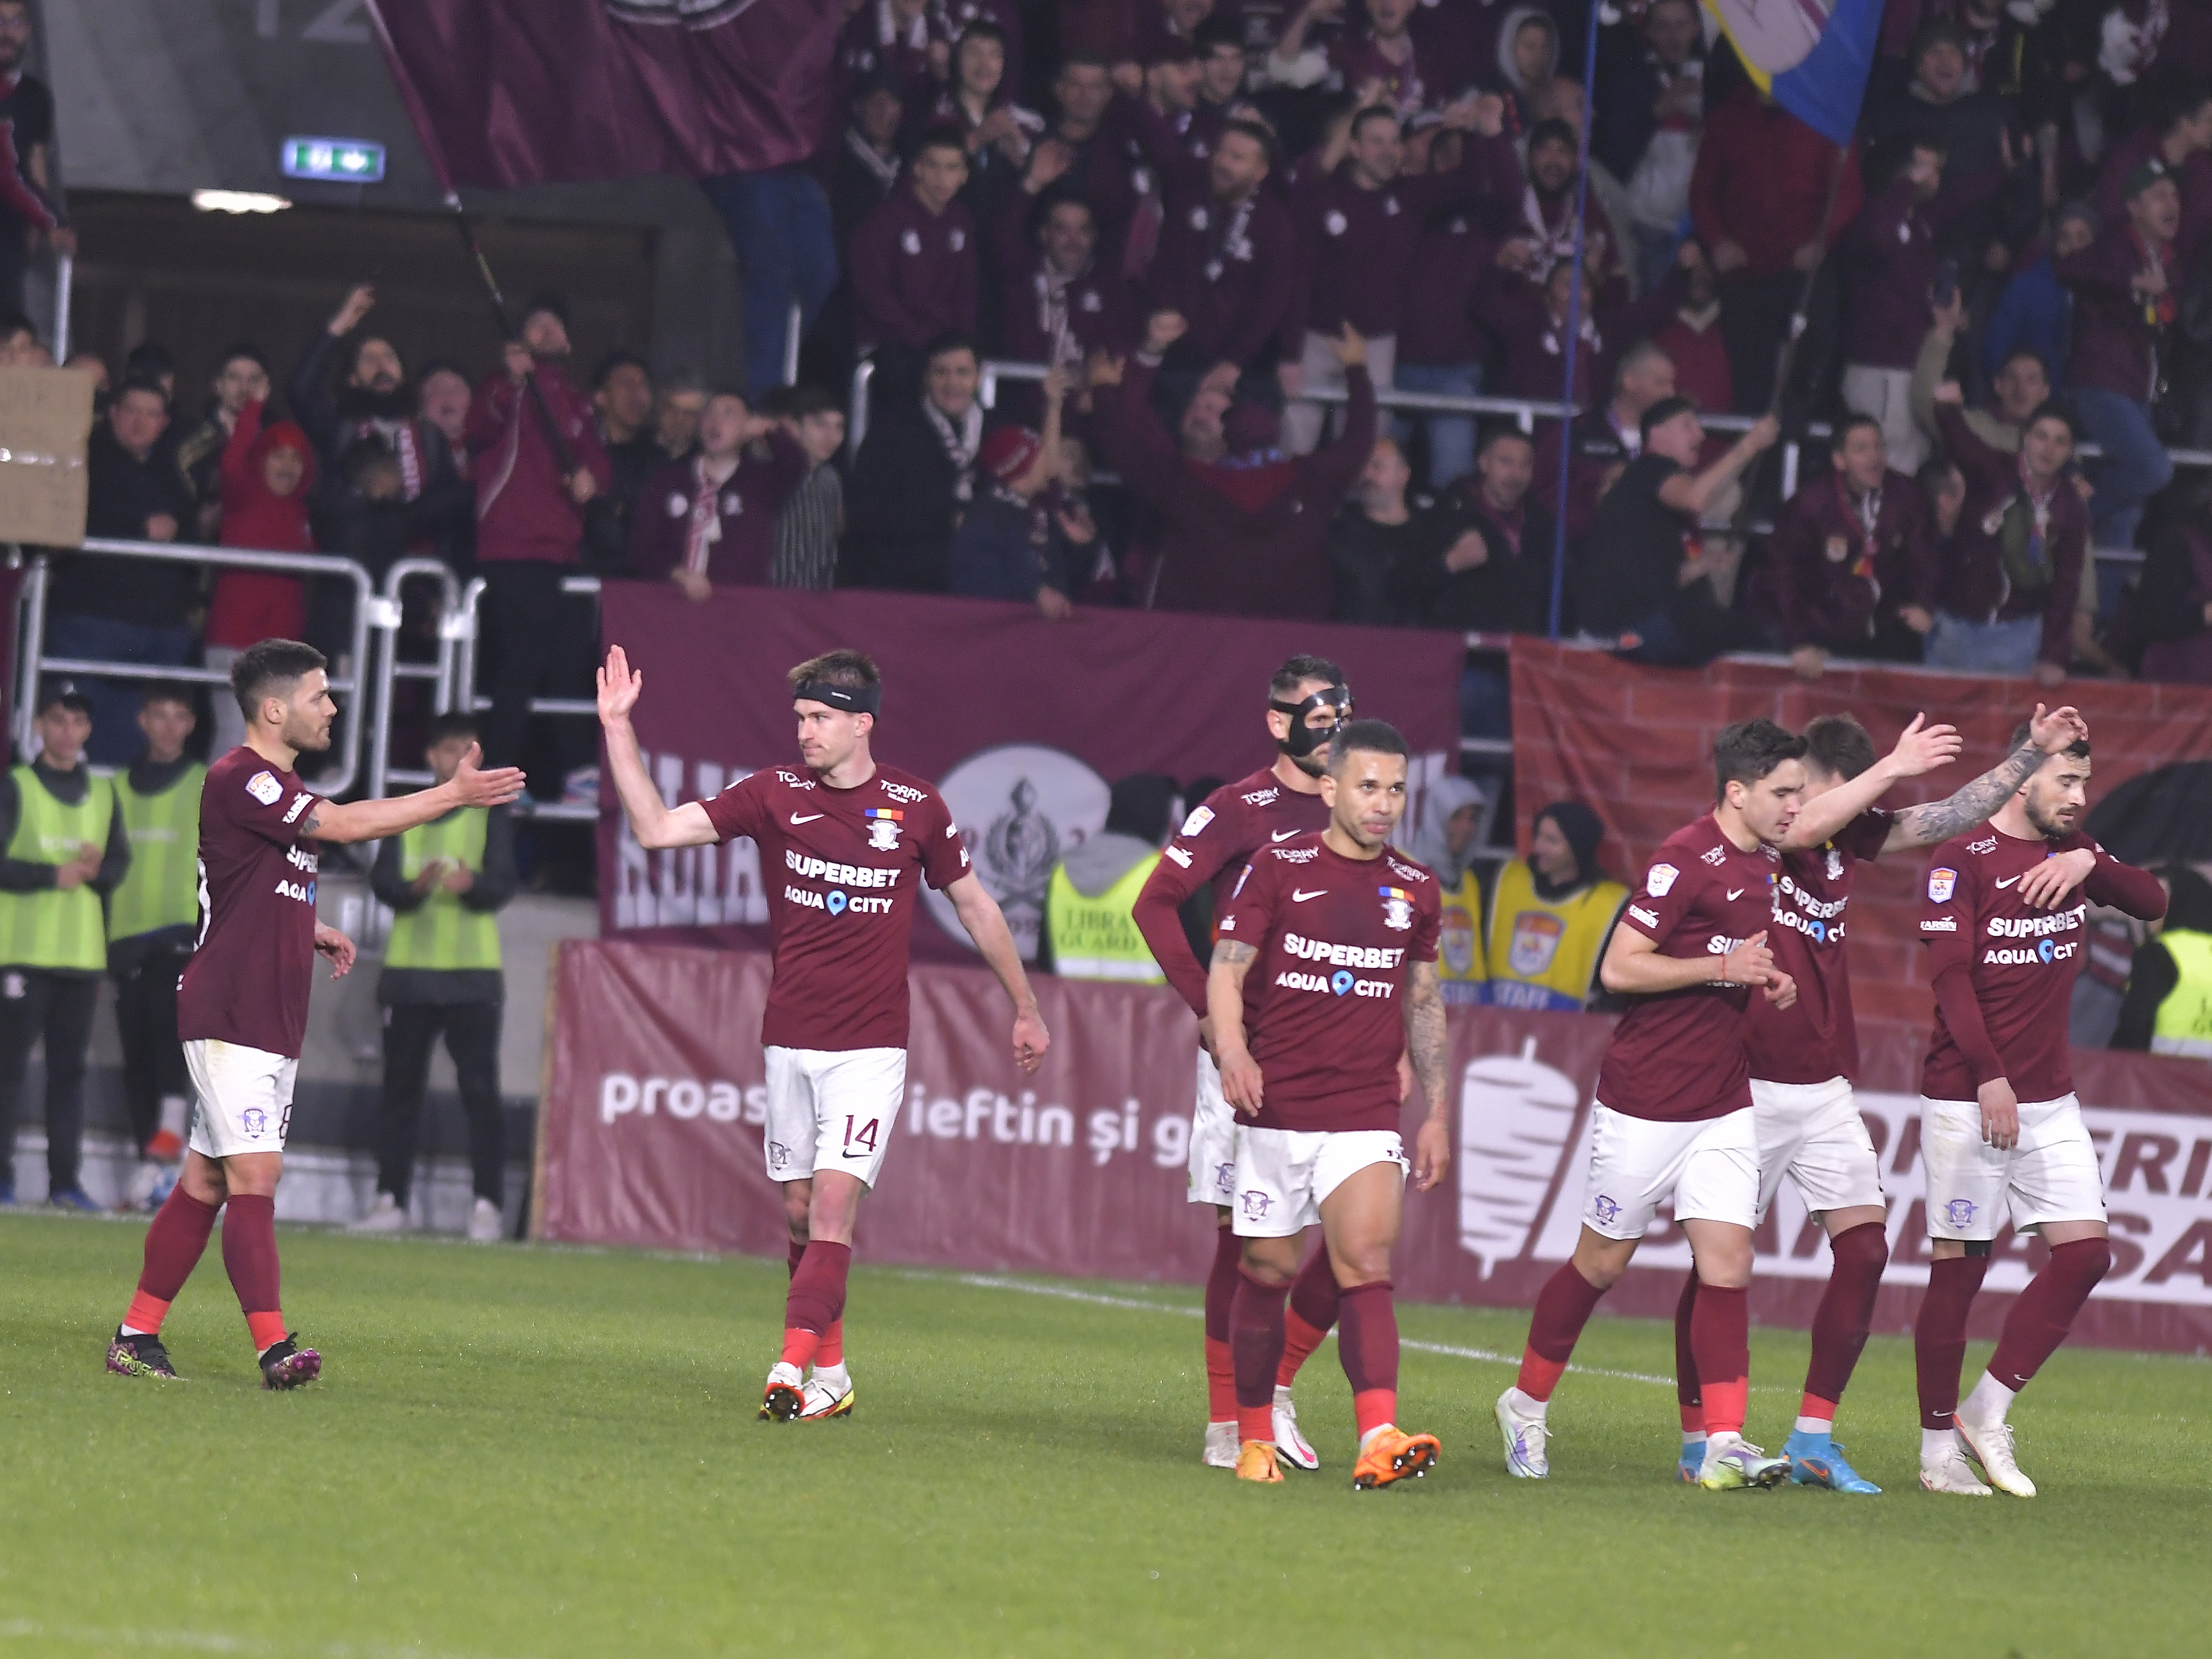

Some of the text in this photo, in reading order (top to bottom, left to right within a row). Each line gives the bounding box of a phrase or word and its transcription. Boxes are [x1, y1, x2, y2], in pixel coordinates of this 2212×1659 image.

[880, 779, 928, 803] TORRY
[785, 848, 901, 888] SUPERBET
[1271, 845, 1319, 860] TORRY
[785, 885, 893, 914] AQUA CITY
[1987, 903, 2087, 938] SUPERBET
[1283, 932, 1405, 968] SUPERBET
[1983, 949, 2039, 965] AQUA
[1275, 970, 1394, 999] AQUA CITY
[602, 1072, 767, 1125] proas
[910, 1083, 1074, 1146] ieftin
[1090, 1098, 1142, 1167] și
[844, 1114, 879, 1152] 14
